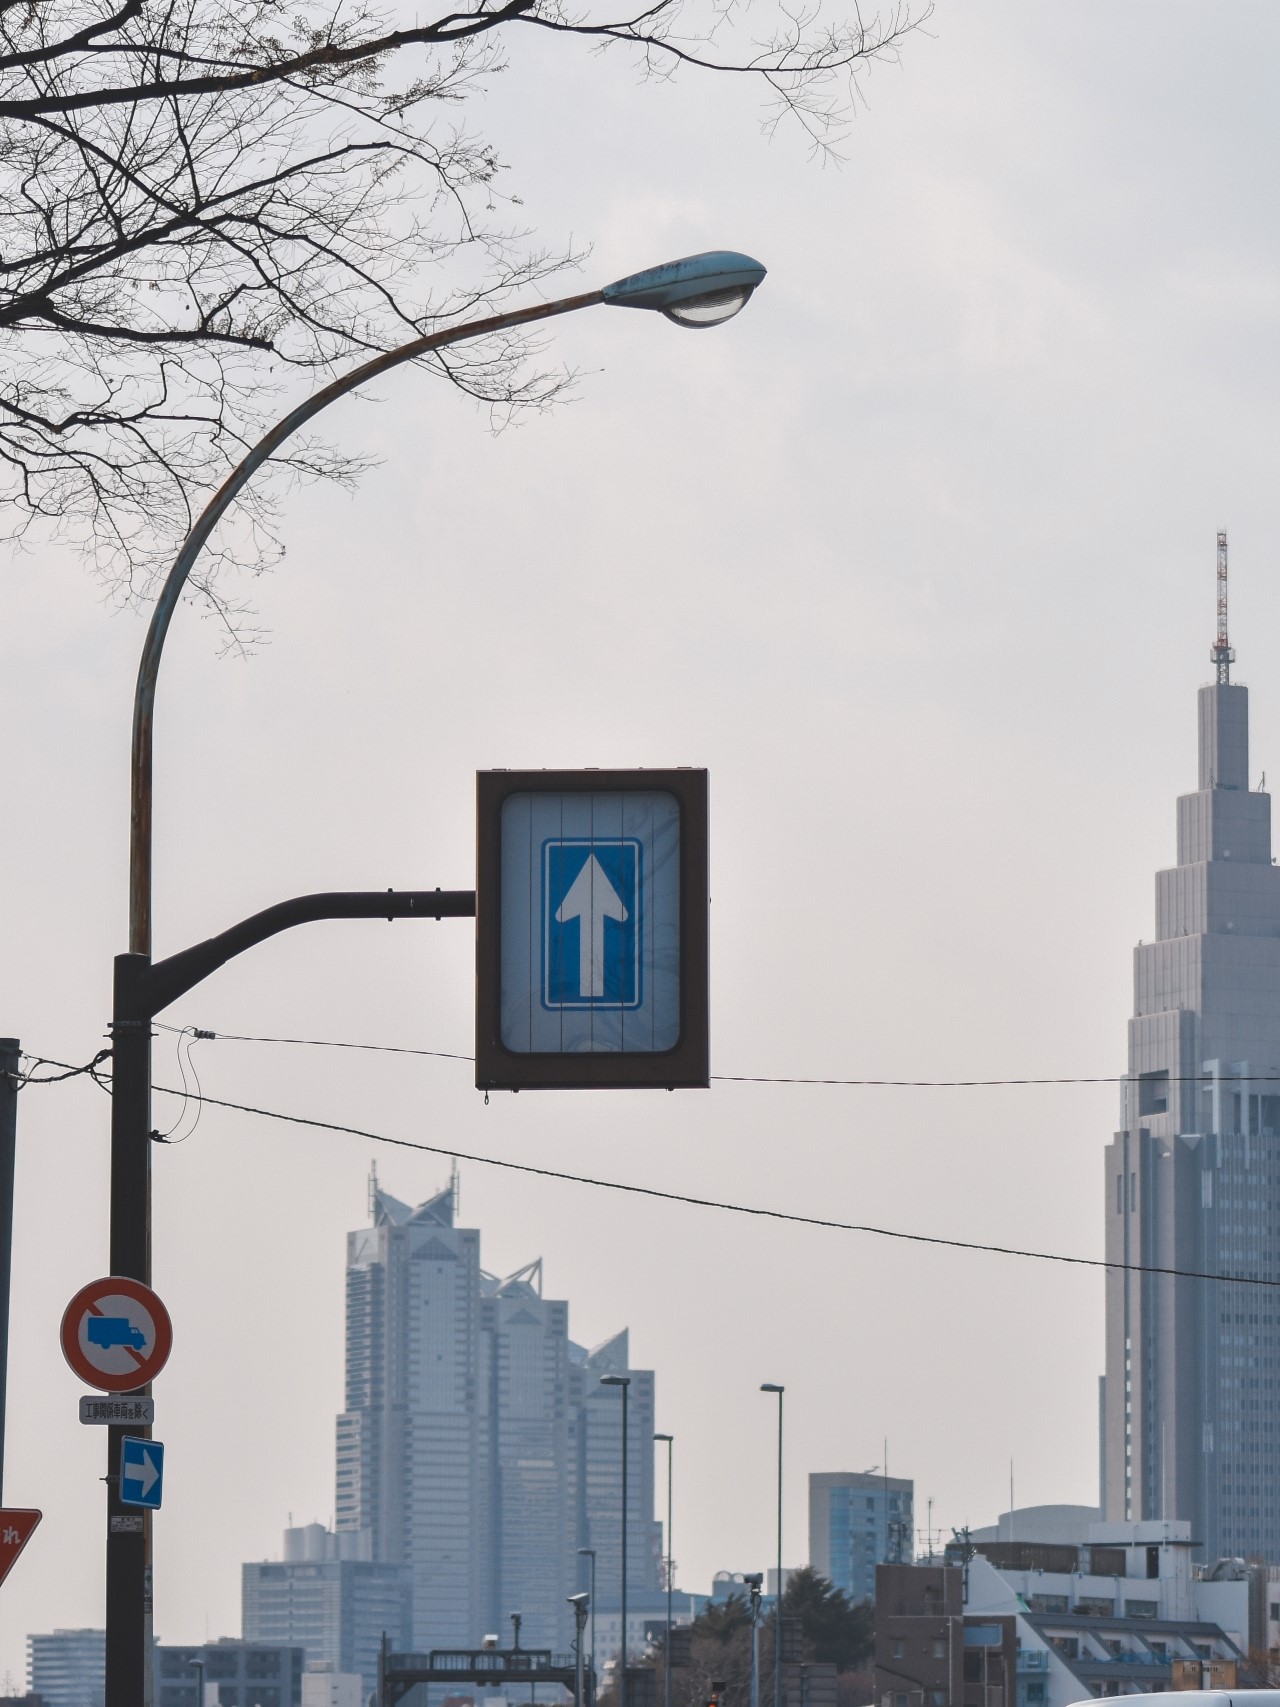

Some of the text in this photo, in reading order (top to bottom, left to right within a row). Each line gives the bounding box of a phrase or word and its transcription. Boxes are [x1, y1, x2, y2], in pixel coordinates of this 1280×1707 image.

[85, 1402, 149, 1420] 工事関係車両を除く
[0, 1525, 21, 1545] れ
